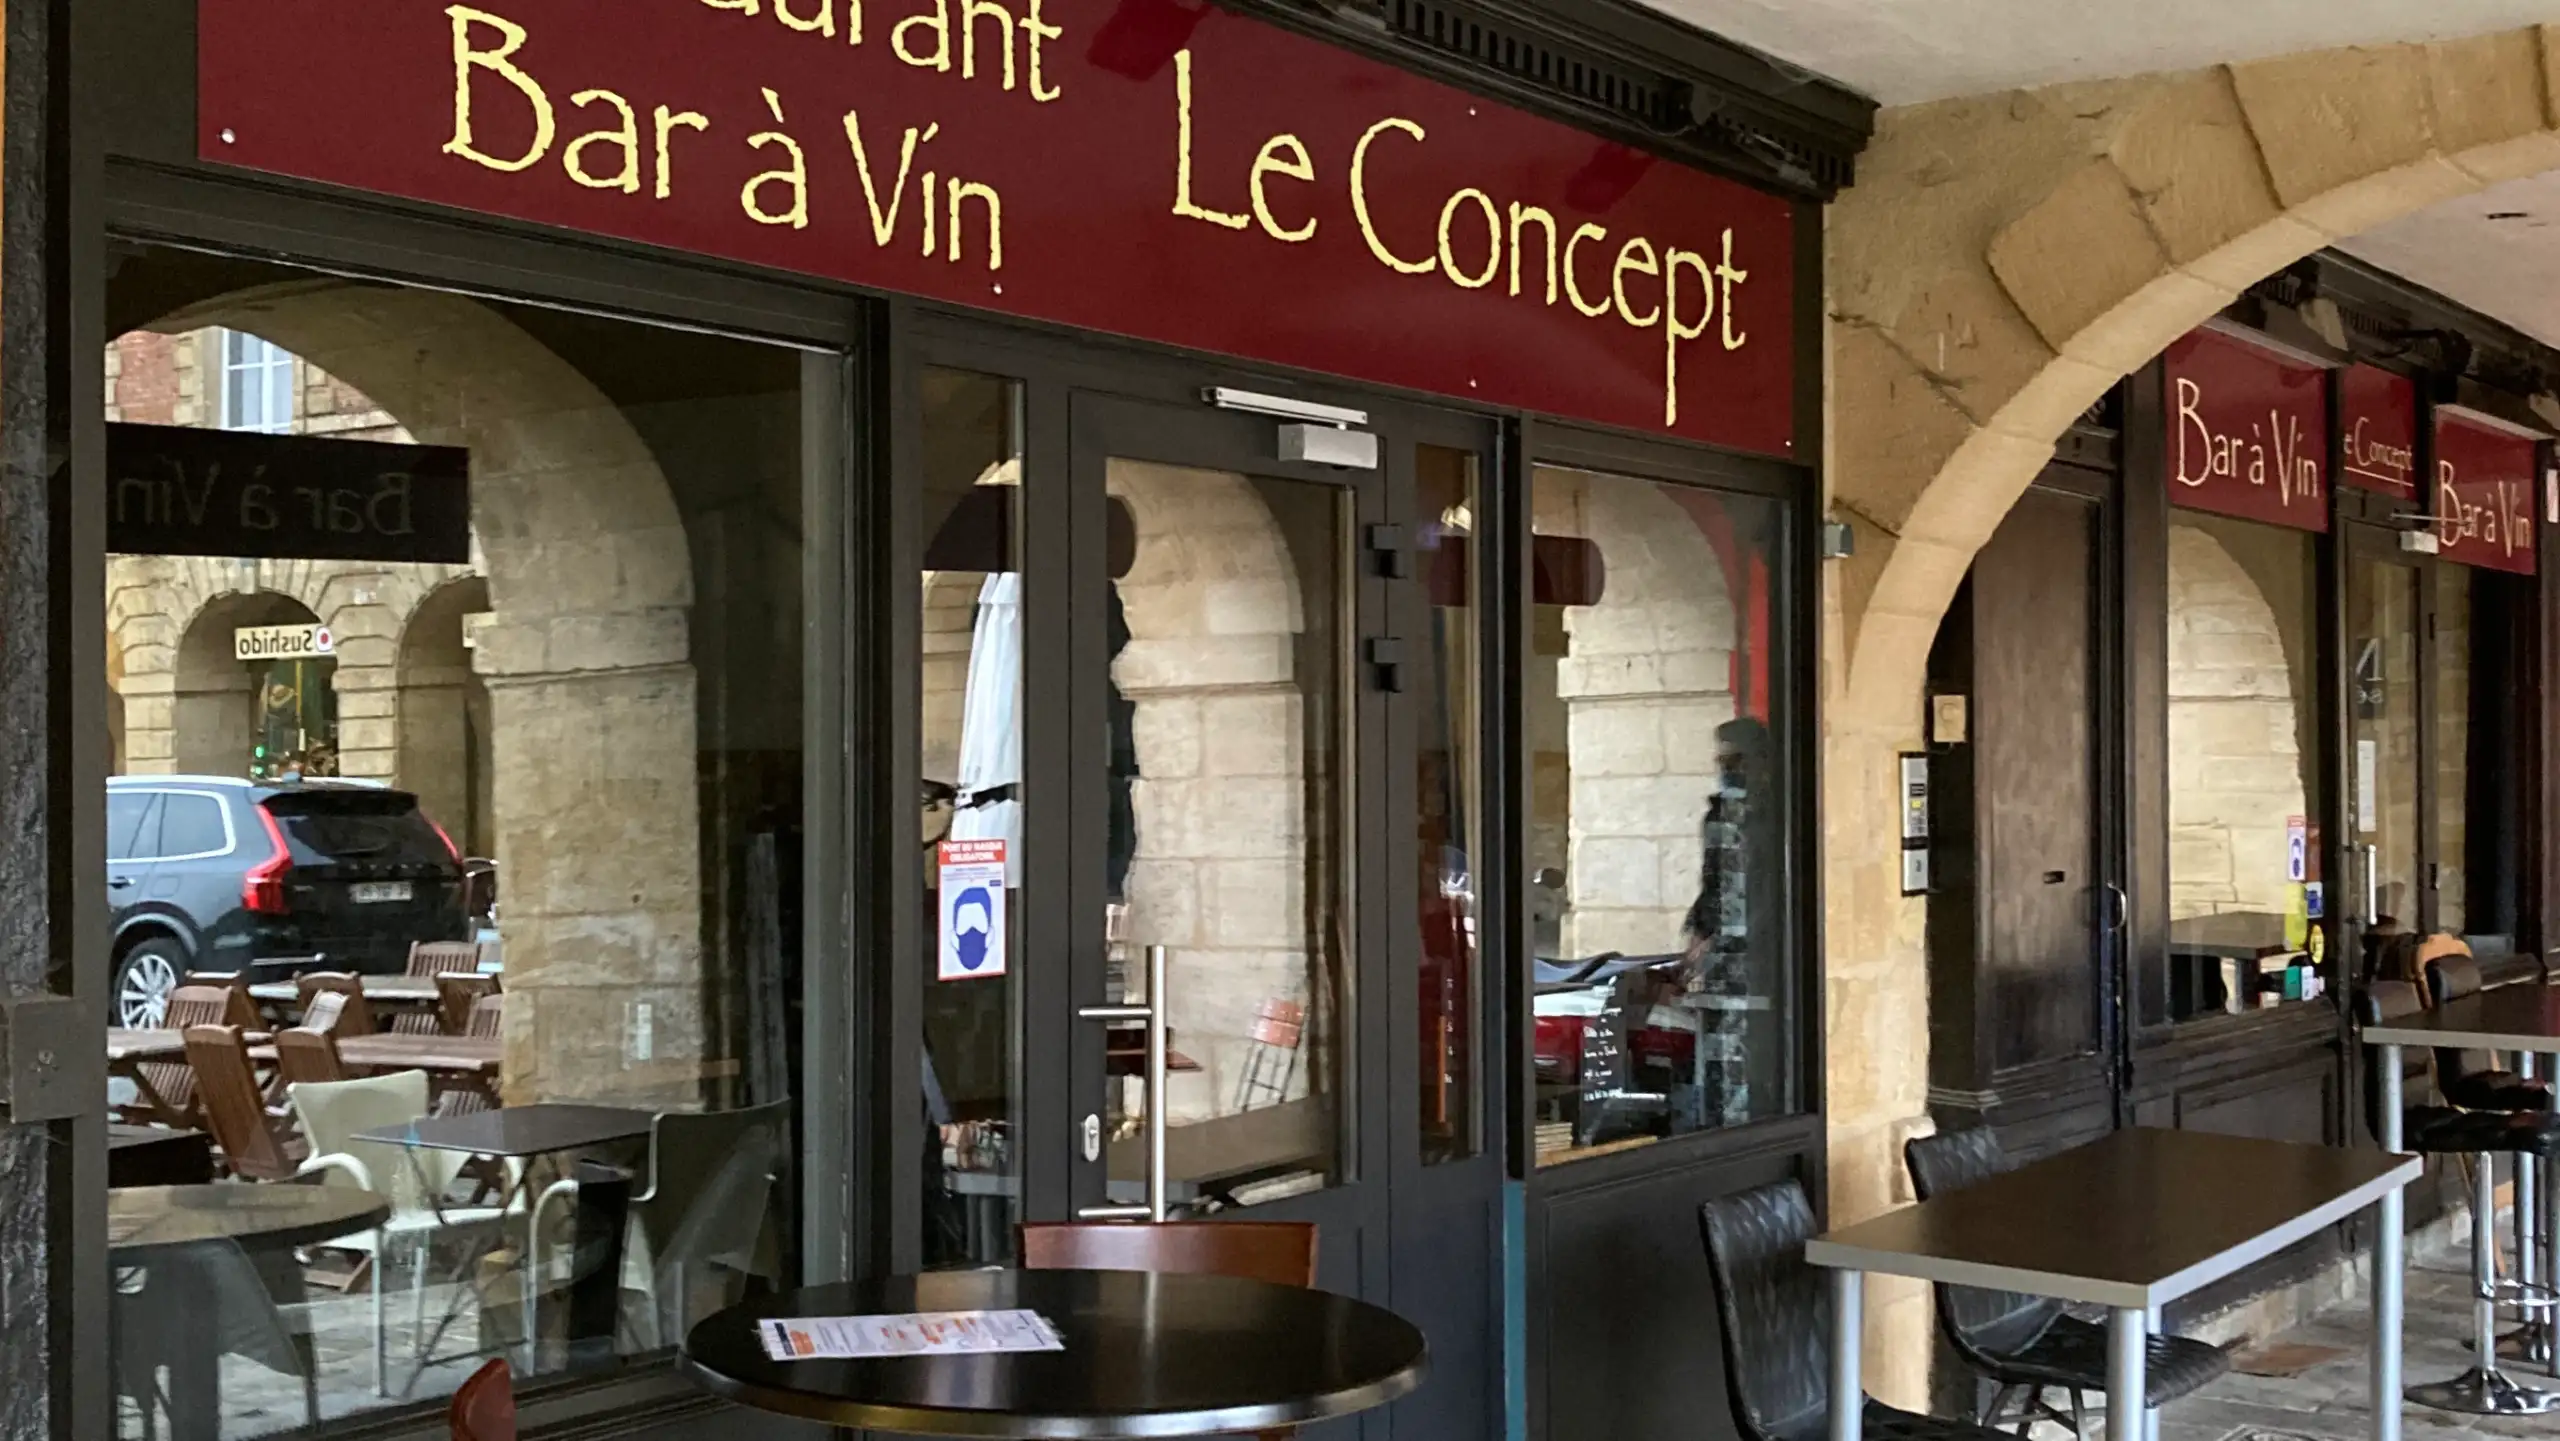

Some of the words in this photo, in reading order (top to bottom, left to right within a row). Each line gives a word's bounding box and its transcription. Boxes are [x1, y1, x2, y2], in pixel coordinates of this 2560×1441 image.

[701, 0, 1062, 102] ant
[442, 4, 709, 200] Bar
[741, 87, 809, 229] à
[843, 110, 1001, 271] Vin
[1172, 48, 1317, 243] Le
[1350, 117, 1748, 427] Concept
[2176, 377, 2244, 487] Bar
[2248, 423, 2265, 485] à
[2269, 408, 2318, 507] Vin
[2439, 459, 2483, 547] Bar
[2484, 492, 2496, 543] à
[2498, 479, 2531, 558] Vin
